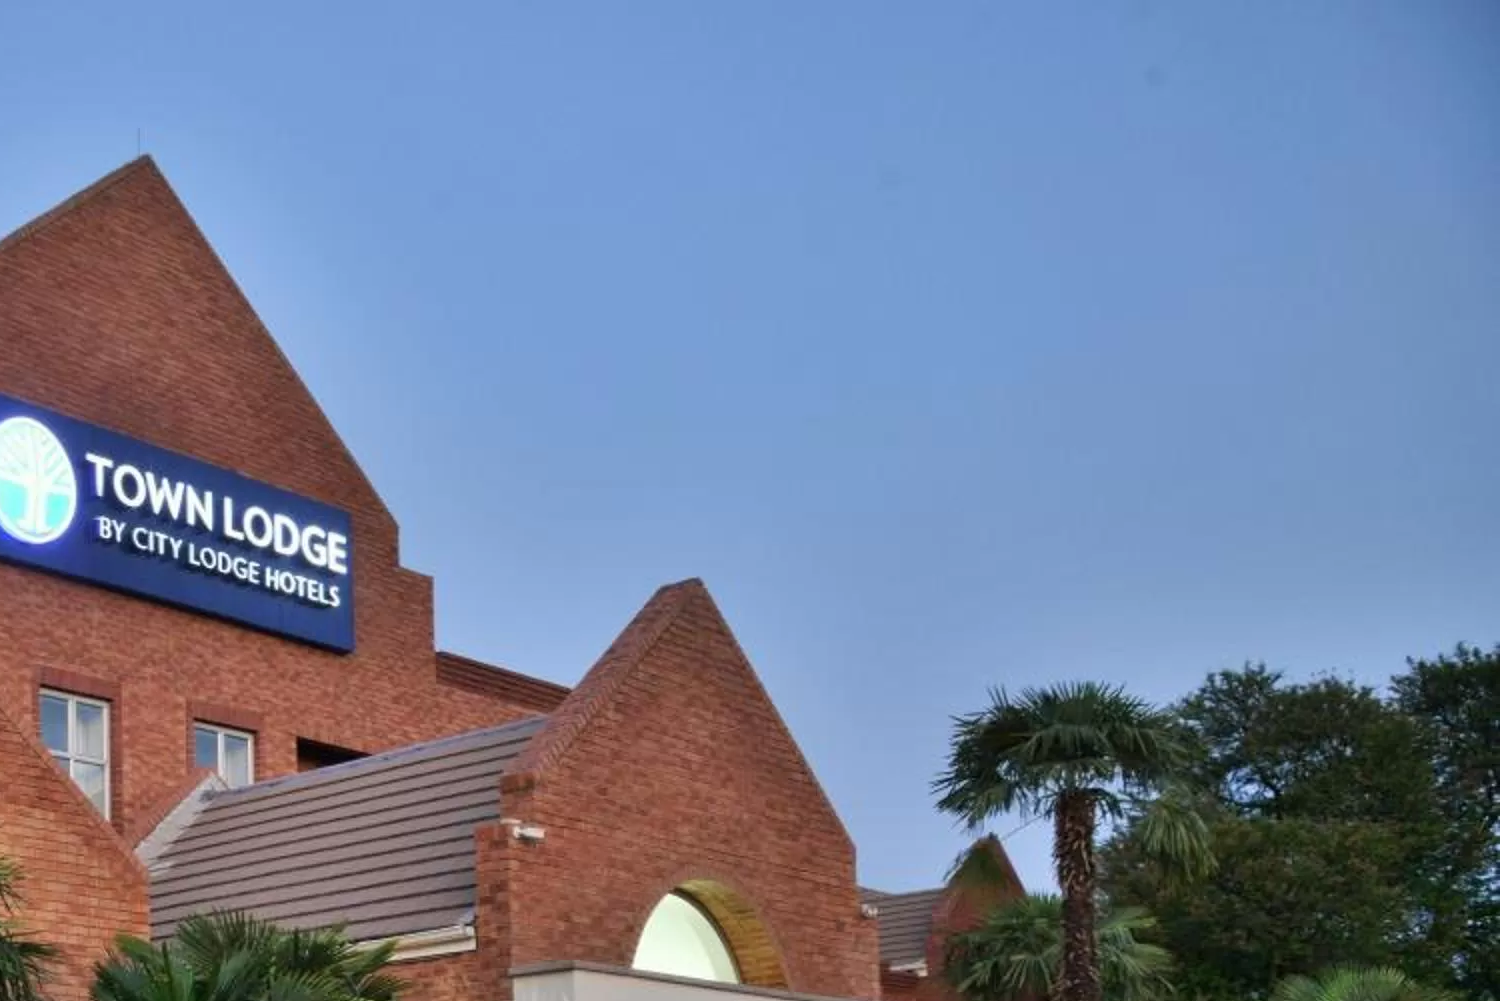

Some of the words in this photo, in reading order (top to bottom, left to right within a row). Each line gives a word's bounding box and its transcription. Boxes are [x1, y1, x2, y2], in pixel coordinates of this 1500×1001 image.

[85, 452, 214, 532] TOWN
[224, 496, 348, 575] LODGE
[97, 515, 126, 543] BY
[133, 527, 184, 560] CITY
[188, 543, 261, 584] LODGE
[265, 567, 341, 608] HOTELS
